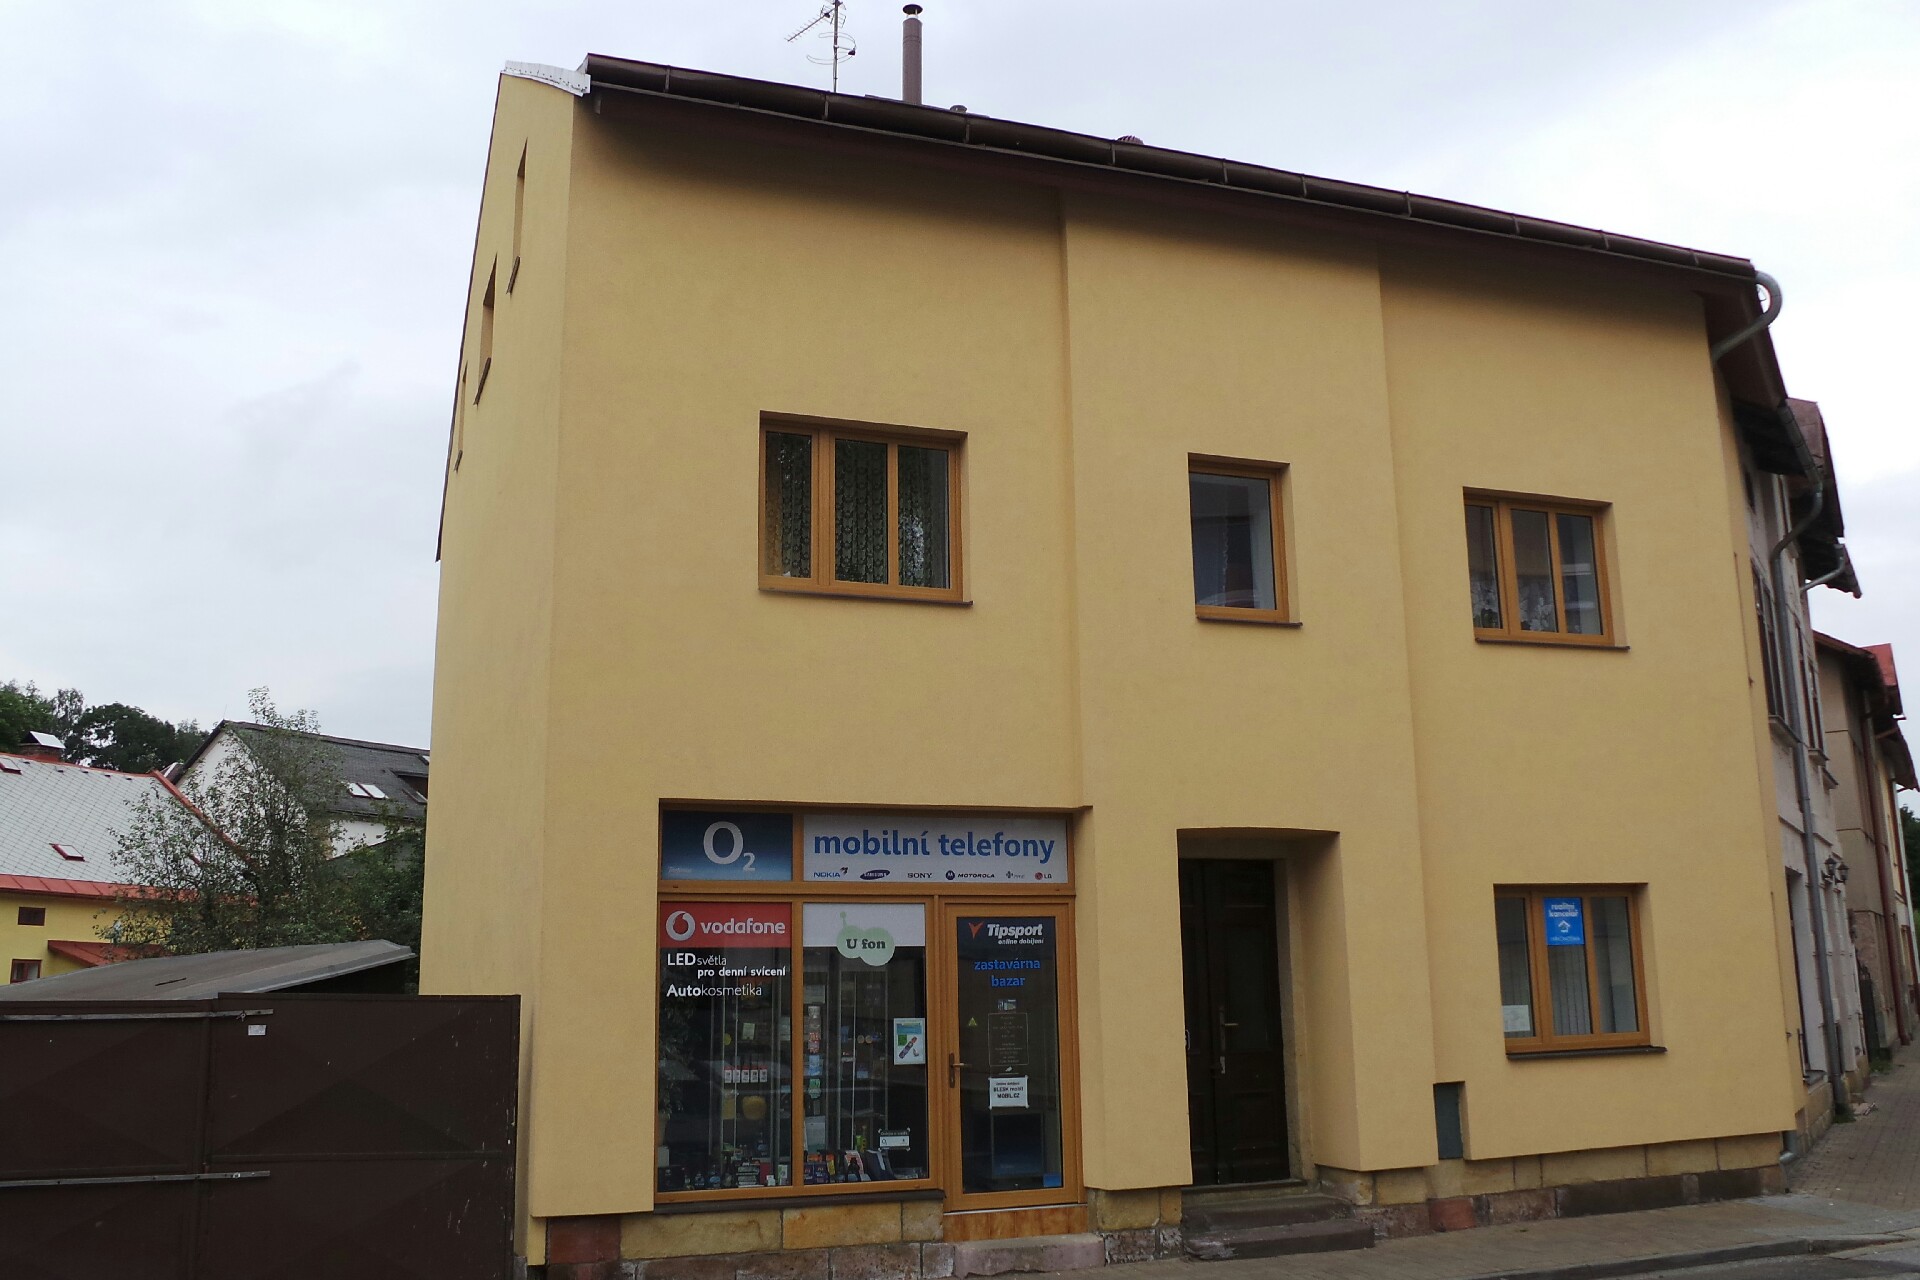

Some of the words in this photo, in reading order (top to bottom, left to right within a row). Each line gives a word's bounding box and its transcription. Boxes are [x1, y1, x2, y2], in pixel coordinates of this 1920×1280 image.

[703, 821, 756, 872] O2
[814, 829, 930, 856] mobilní
[938, 831, 1055, 865] telefony
[700, 917, 786, 934] vodafone
[987, 923, 1043, 939] Tipsport
[846, 938, 857, 949] U
[861, 939, 886, 949] fon
[974, 957, 1041, 971] zastavárna
[697, 968, 715, 980] pro
[718, 966, 748, 977] denní
[750, 965, 786, 977] svícení
[991, 975, 1026, 987] bazar
[666, 983, 762, 997] Autokosmetika
